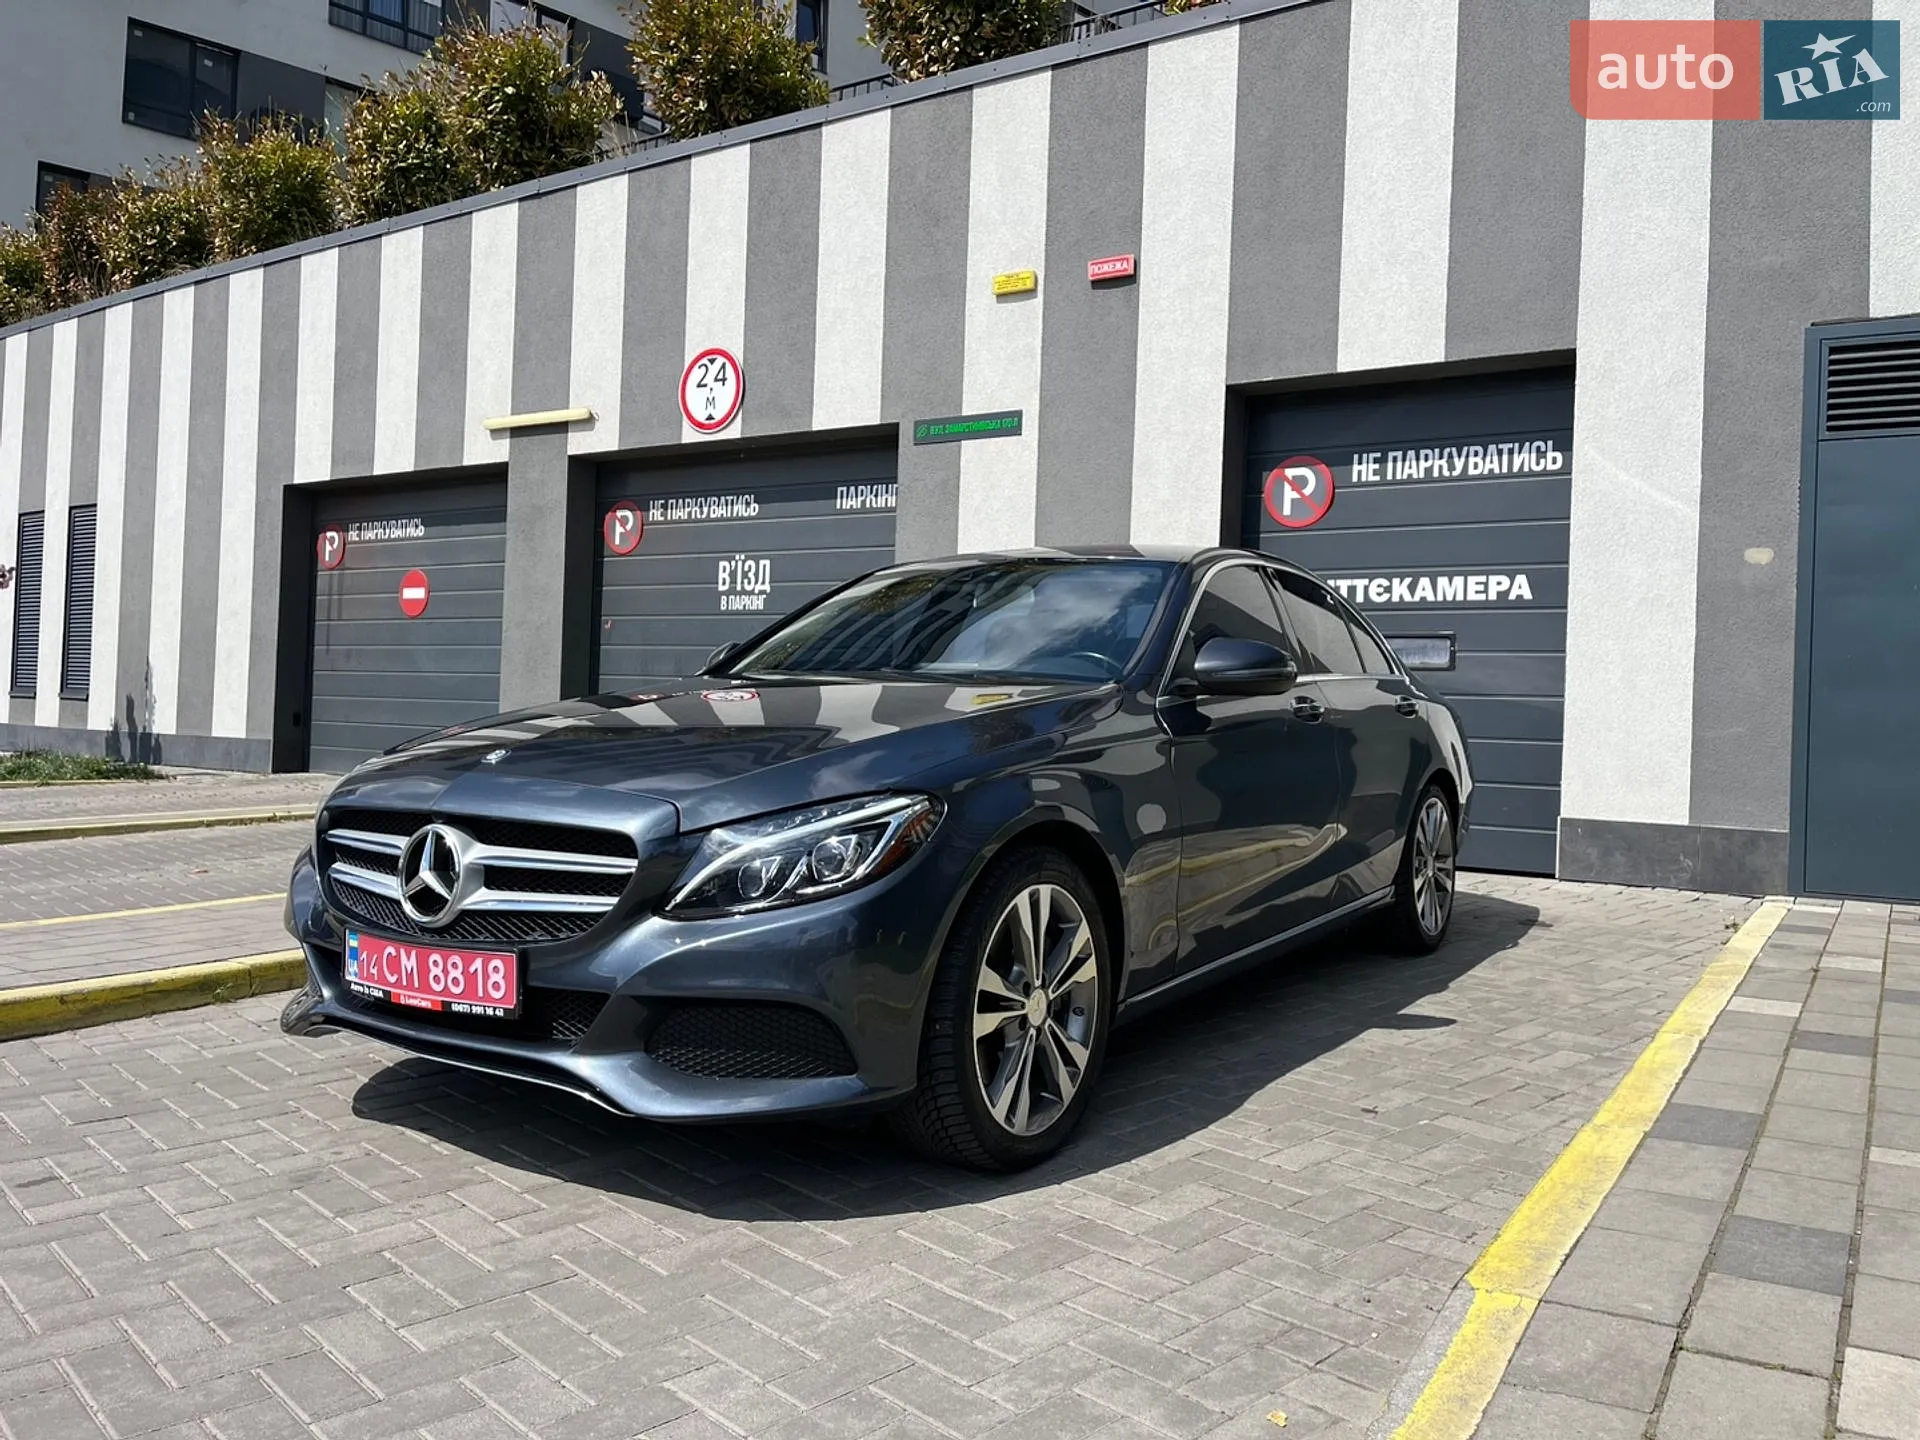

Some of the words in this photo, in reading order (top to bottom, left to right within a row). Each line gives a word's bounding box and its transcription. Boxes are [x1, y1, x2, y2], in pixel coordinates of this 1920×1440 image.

[1091, 258, 1129, 276] ПОЖЕЖА
[1351, 452, 1381, 482] НЕ
[1386, 440, 1563, 481] ПАРКУВАТИСЬ
[649, 500, 665, 521] НЕ
[667, 494, 759, 520] ПАРКУВАТИСЬ
[348, 523, 360, 541] НЕ
[361, 518, 425, 541] ПАРКУВАТИСЬ
[720, 595, 728, 611] В
[728, 594, 767, 611] ПАРКІНГ
[1326, 574, 1533, 604] ТТЄКАМЕРА
[360, 950, 378, 981] 14
[428, 953, 506, 1000] 8818
